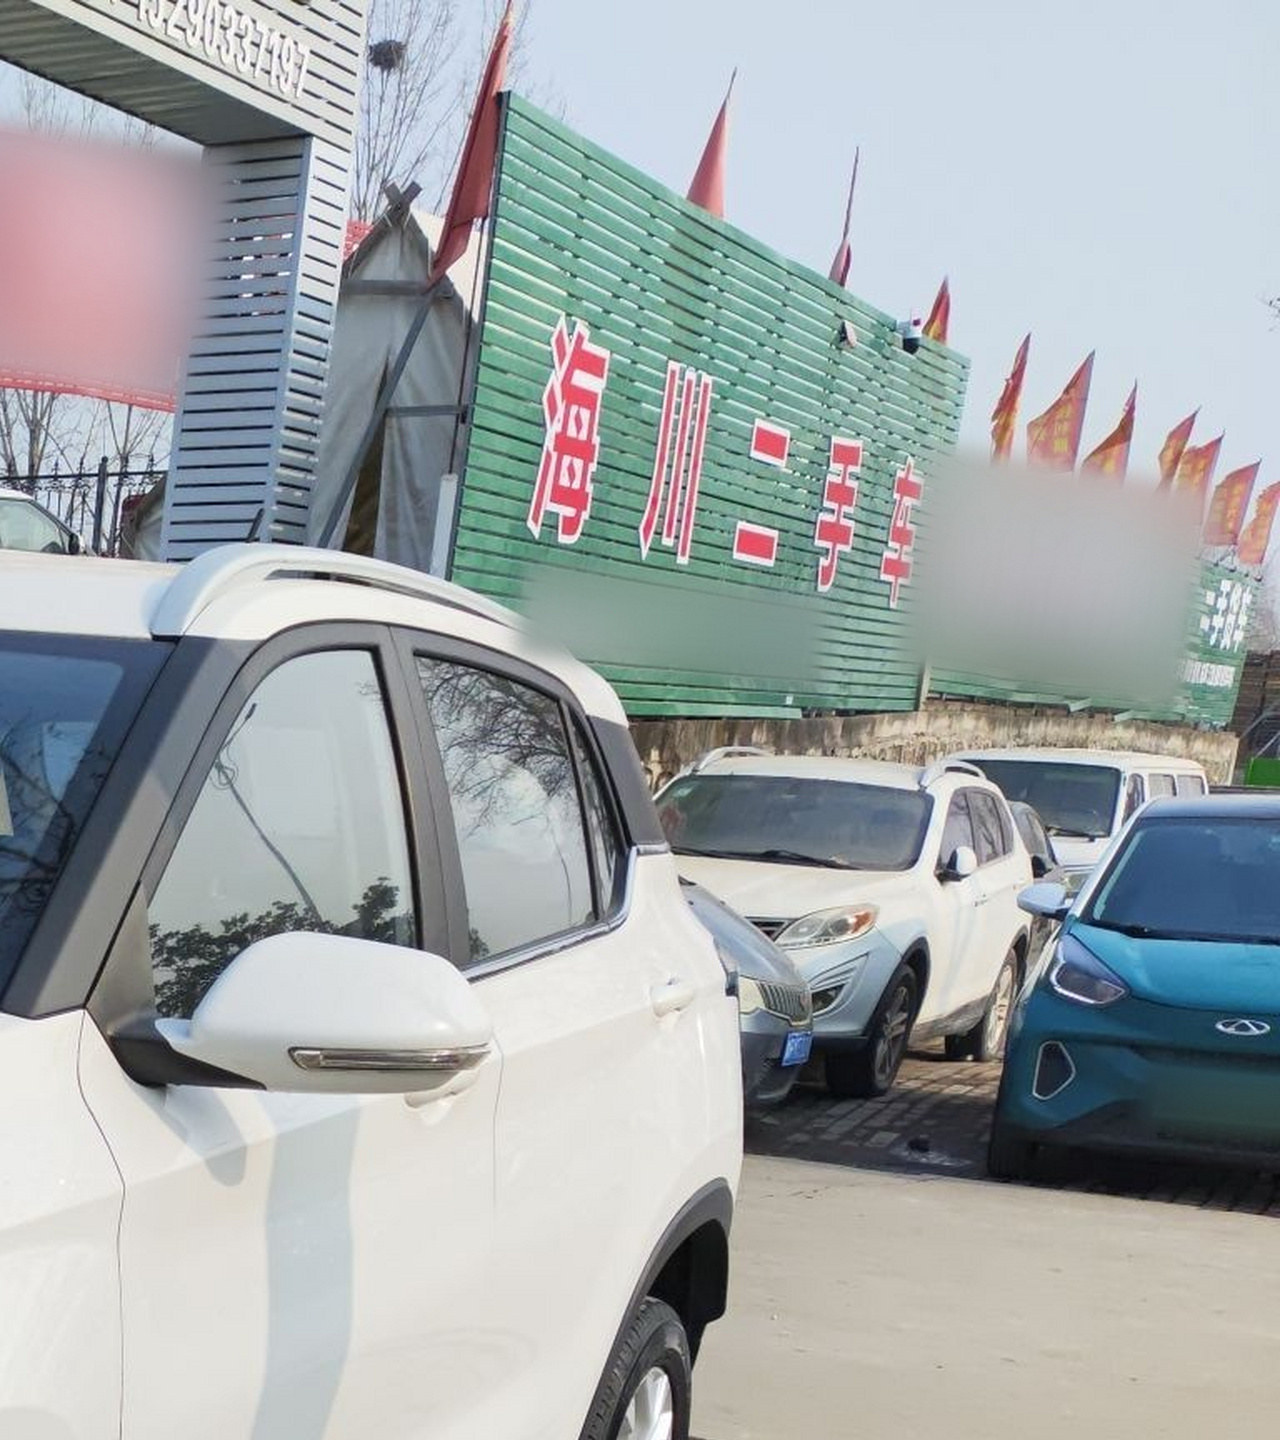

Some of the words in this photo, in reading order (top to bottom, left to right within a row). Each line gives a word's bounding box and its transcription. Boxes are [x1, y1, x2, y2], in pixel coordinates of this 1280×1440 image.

[528, 312, 924, 609] 海川二手车
